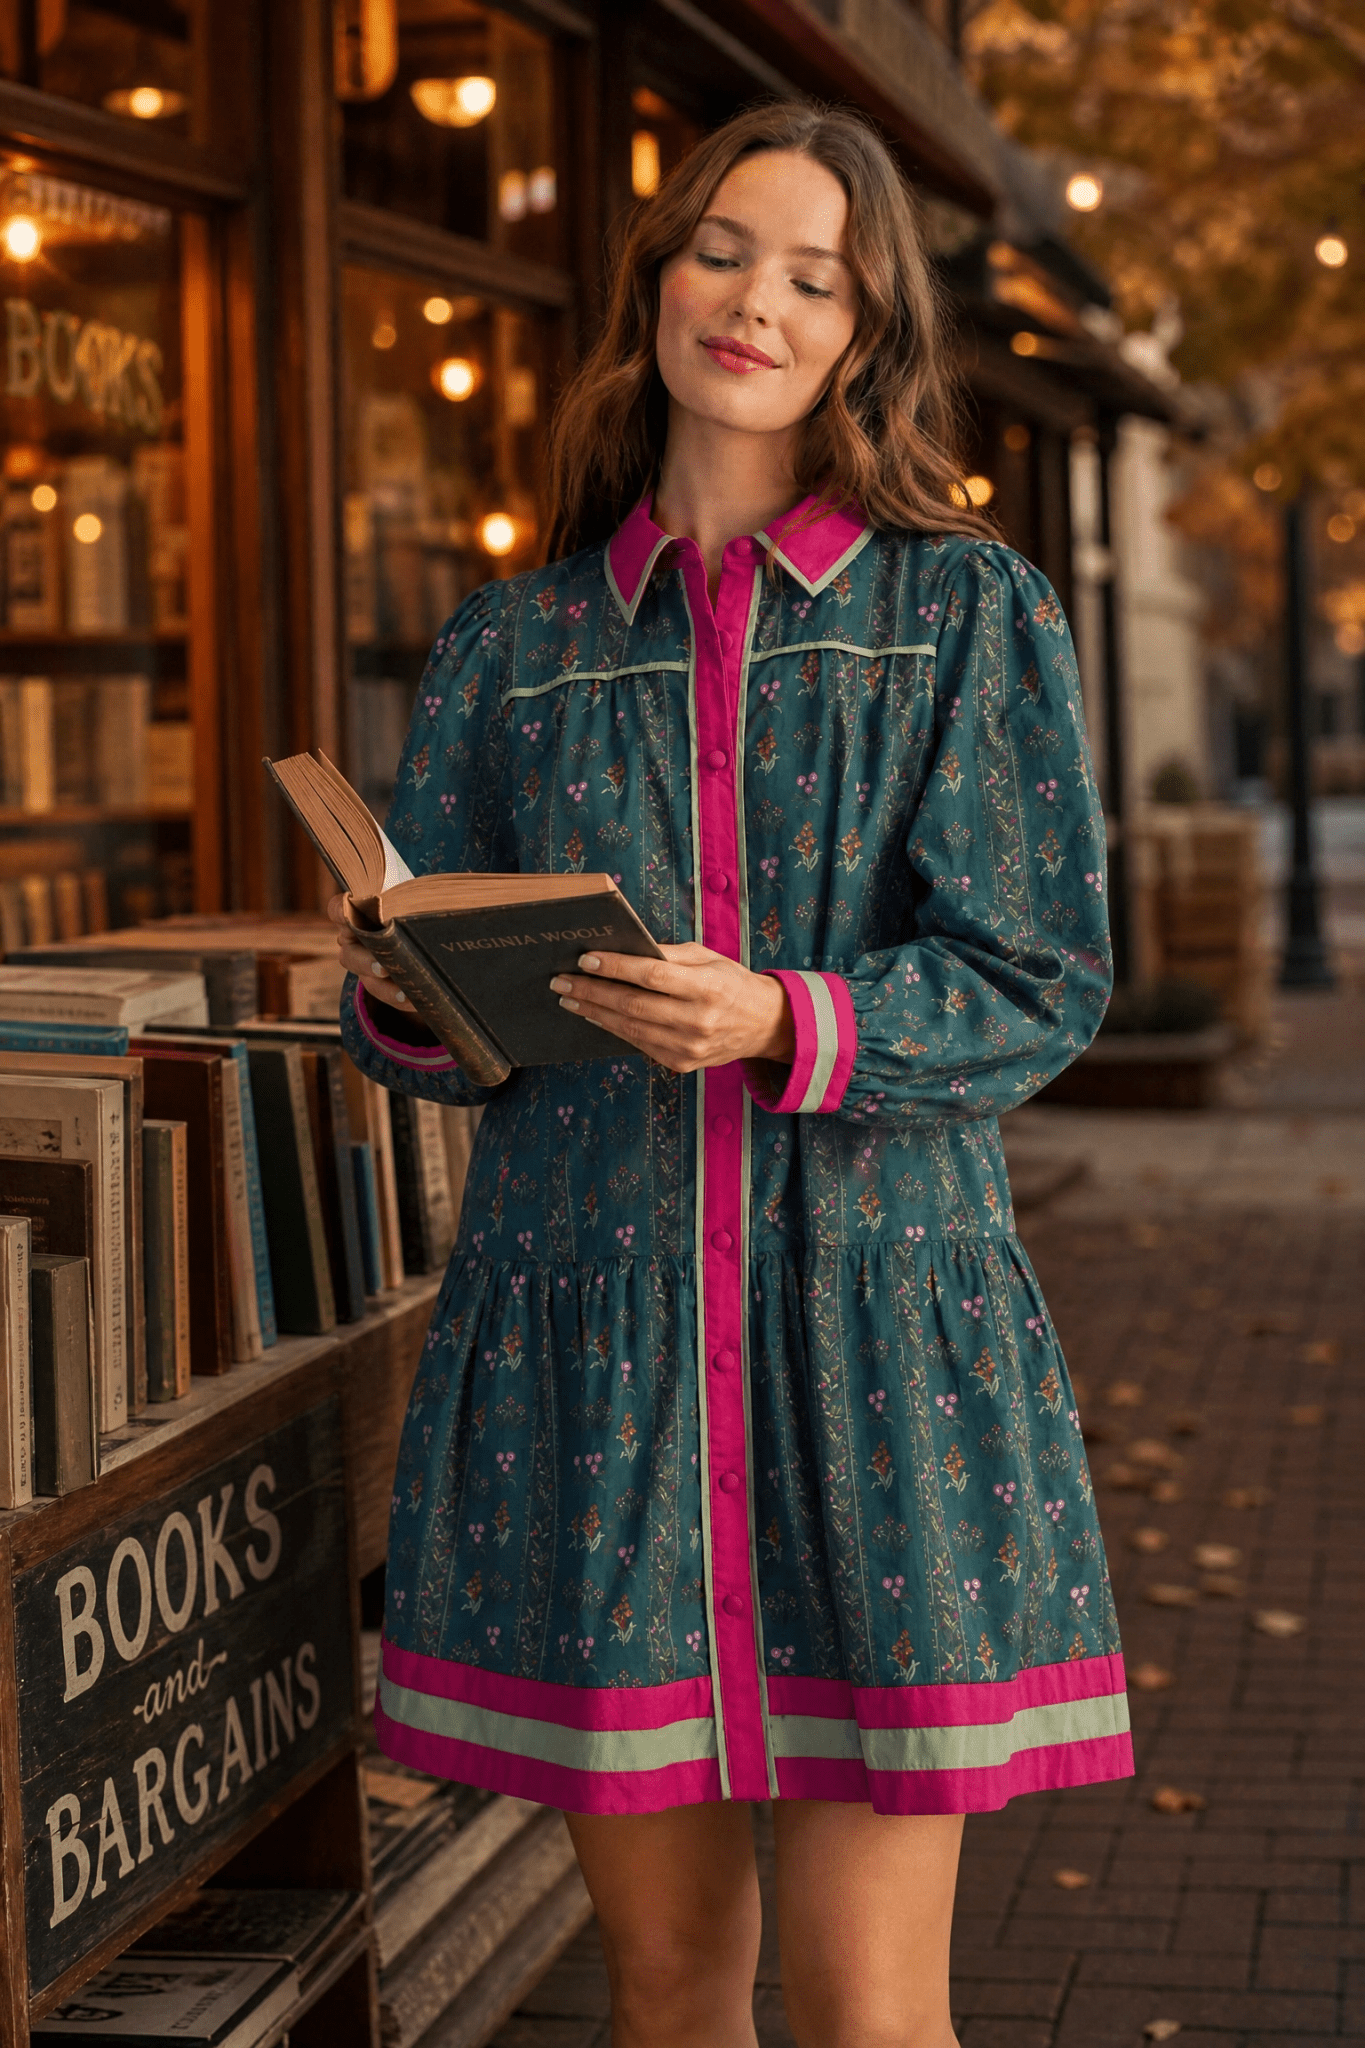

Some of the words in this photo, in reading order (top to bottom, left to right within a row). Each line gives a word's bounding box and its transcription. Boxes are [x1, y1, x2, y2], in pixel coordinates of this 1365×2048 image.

[440, 934, 538, 952] VIRGINIA
[540, 925, 615, 943] WOOLF
[55, 1464, 281, 1703] BOOKS
[133, 1638, 228, 1723] and
[45, 1642, 320, 1928] BARGAINS
